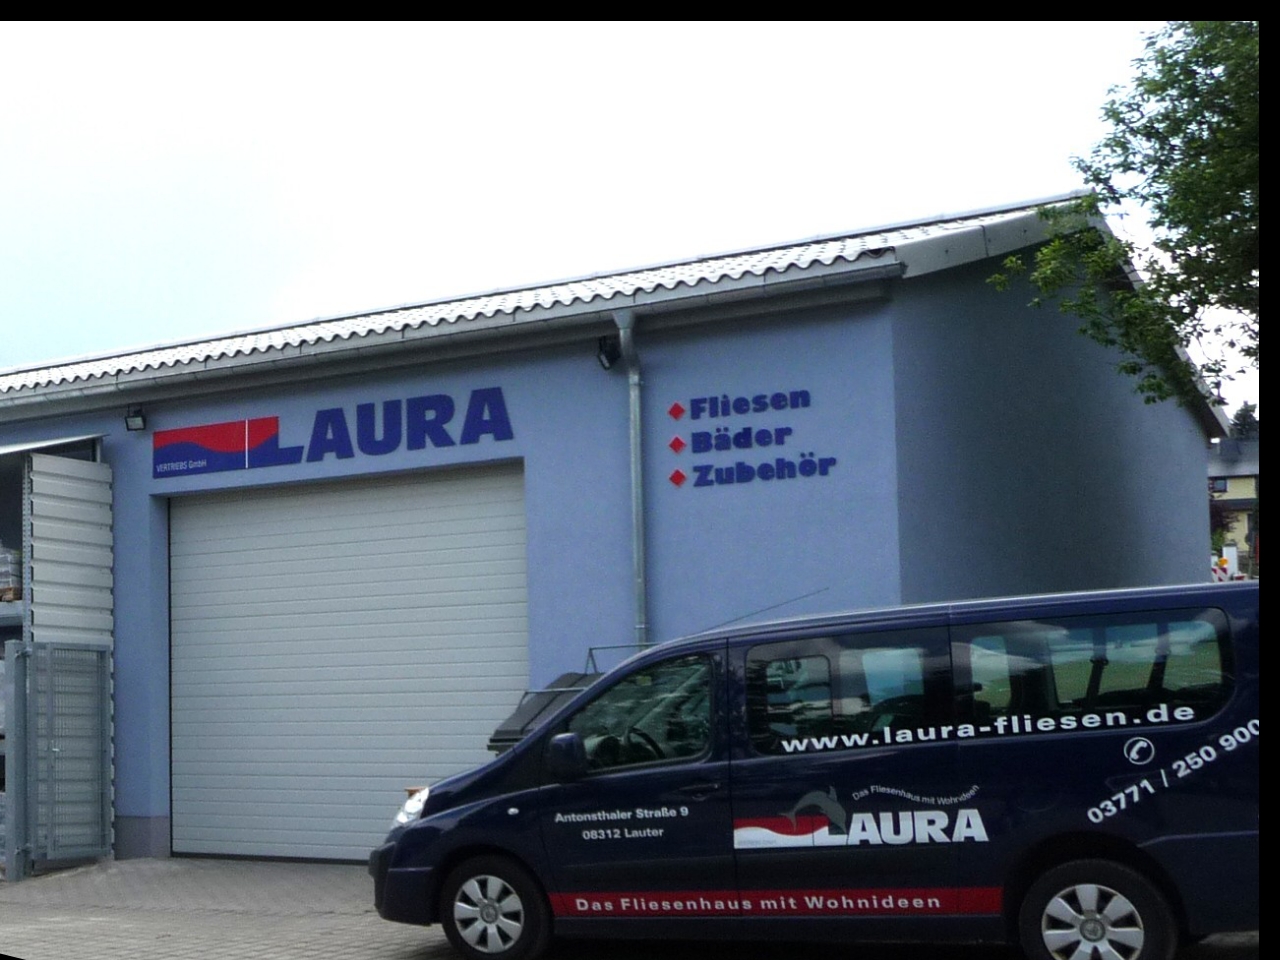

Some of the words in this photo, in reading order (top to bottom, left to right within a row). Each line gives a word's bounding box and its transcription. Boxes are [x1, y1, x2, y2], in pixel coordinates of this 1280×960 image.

[690, 390, 811, 420] Fliesen
[247, 386, 514, 470] LAURA
[691, 426, 793, 453] Bäder
[693, 451, 837, 487] Zubehör
[781, 703, 1195, 753] www.laura-fliesen.de
[852, 788, 870, 801] Das
[870, 785, 921, 803] Fliesenhaus
[921, 796, 936, 805] mit
[936, 784, 980, 806] Wohnideen
[1087, 778, 1155, 824] 03771
[1171, 745, 1217, 778] 250
[555, 810, 632, 823] Antonsthaler
[635, 807, 677, 819] Straße
[680, 806, 689, 817] 9
[813, 808, 989, 846] LAURA
[582, 828, 622, 840] 08312
[624, 827, 664, 839] Lauter
[575, 898, 614, 912] Das
[621, 896, 753, 911] Fliesenhaus
[760, 896, 798, 910] mit
[805, 894, 941, 910] Wohnideen
